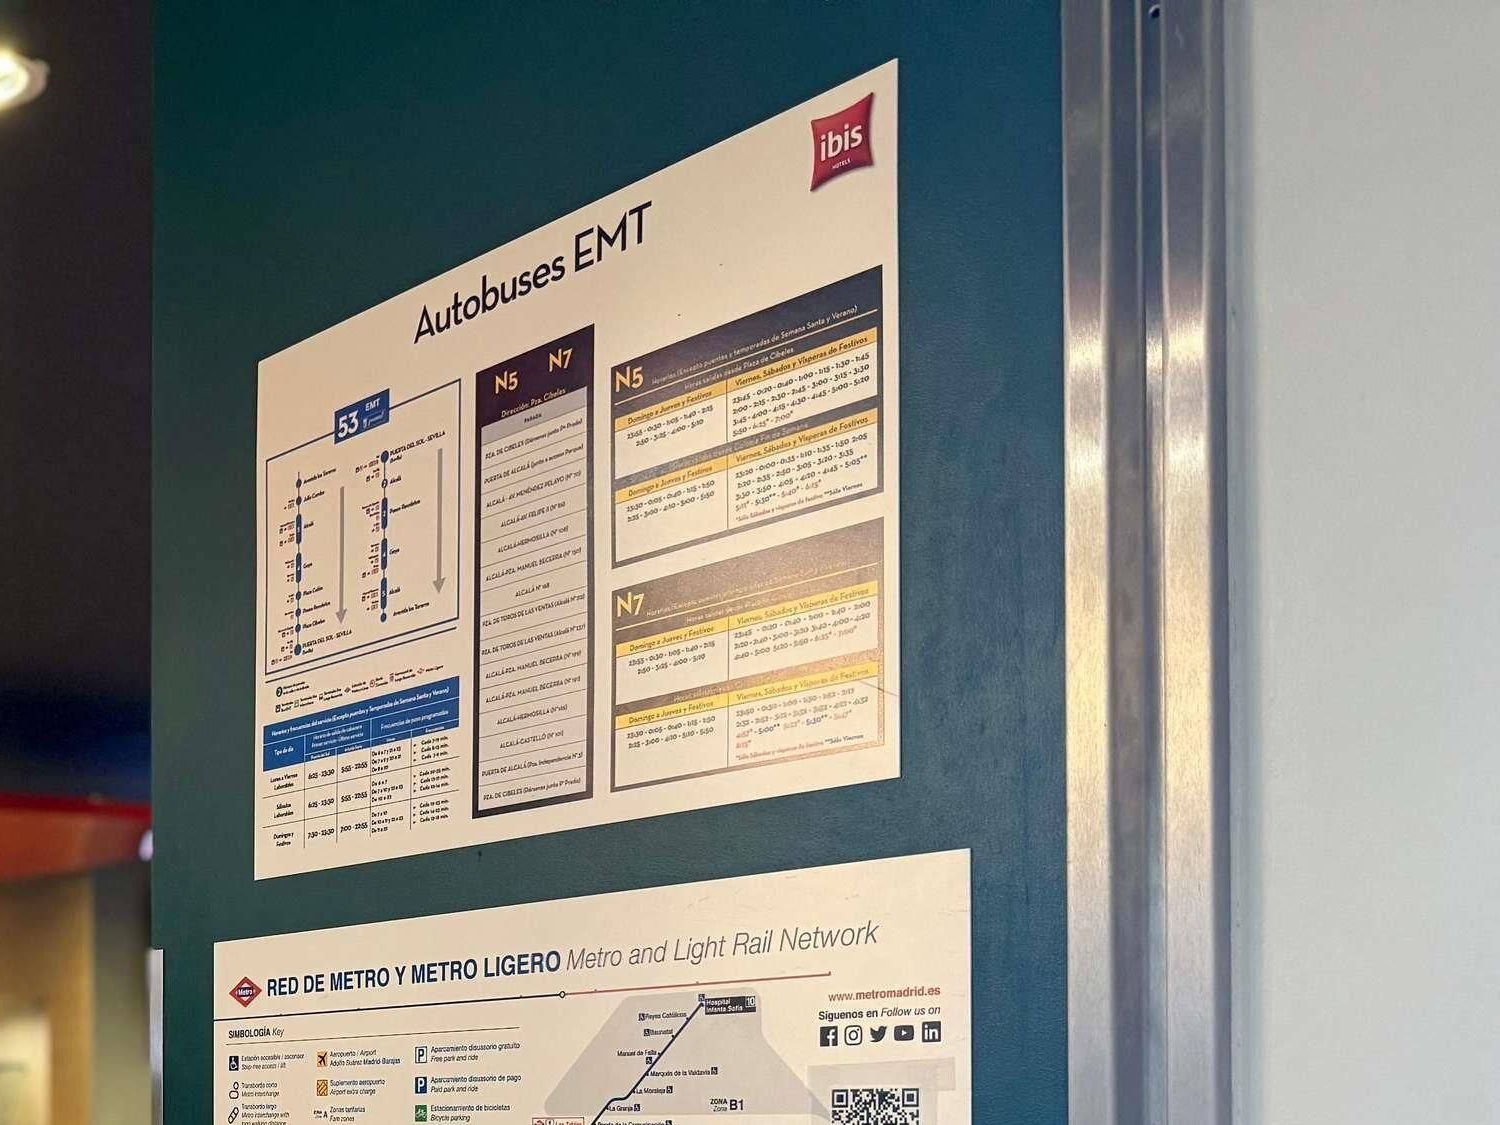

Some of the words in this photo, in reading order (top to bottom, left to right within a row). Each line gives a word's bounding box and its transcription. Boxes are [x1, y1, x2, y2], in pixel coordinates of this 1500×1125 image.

[821, 124, 862, 161] ibis
[414, 256, 565, 344] Autobuses
[575, 200, 652, 272] EMT
[781, 326, 805, 339] Semana
[807, 319, 823, 329] Santa
[763, 364, 790, 377] Sábados
[839, 338, 867, 351] Festivos
[495, 371, 518, 394] N5
[549, 348, 572, 372] N7
[616, 366, 643, 392] N5
[365, 398, 380, 411] EMT
[543, 388, 565, 401] Cibeles
[628, 412, 653, 428] Domingo
[659, 403, 679, 417] Jueves
[687, 391, 712, 406] Festivos
[338, 410, 358, 438] 53
[617, 592, 644, 617] N7
[268, 977, 298, 997] RED
[304, 974, 324, 993] DE
[330, 967, 389, 991] METRO
[395, 966, 406, 985] Y
[412, 959, 477, 984] METRO
[484, 951, 561, 977] LIGERO
[566, 947, 622, 971] Metro
[629, 941, 666, 965] and
[674, 936, 726, 965] Light
[732, 930, 772, 956] Rail
[779, 920, 879, 952] Network
[705, 996, 731, 1006] Hospital
[828, 986, 941, 1002] www.metromadrid.es
[881, 1007, 909, 1017] Follow
[228, 1028, 271, 1039] SIMBOLOGÍA
[272, 1027, 284, 1038] Key
[730, 1099, 743, 1110] B1
